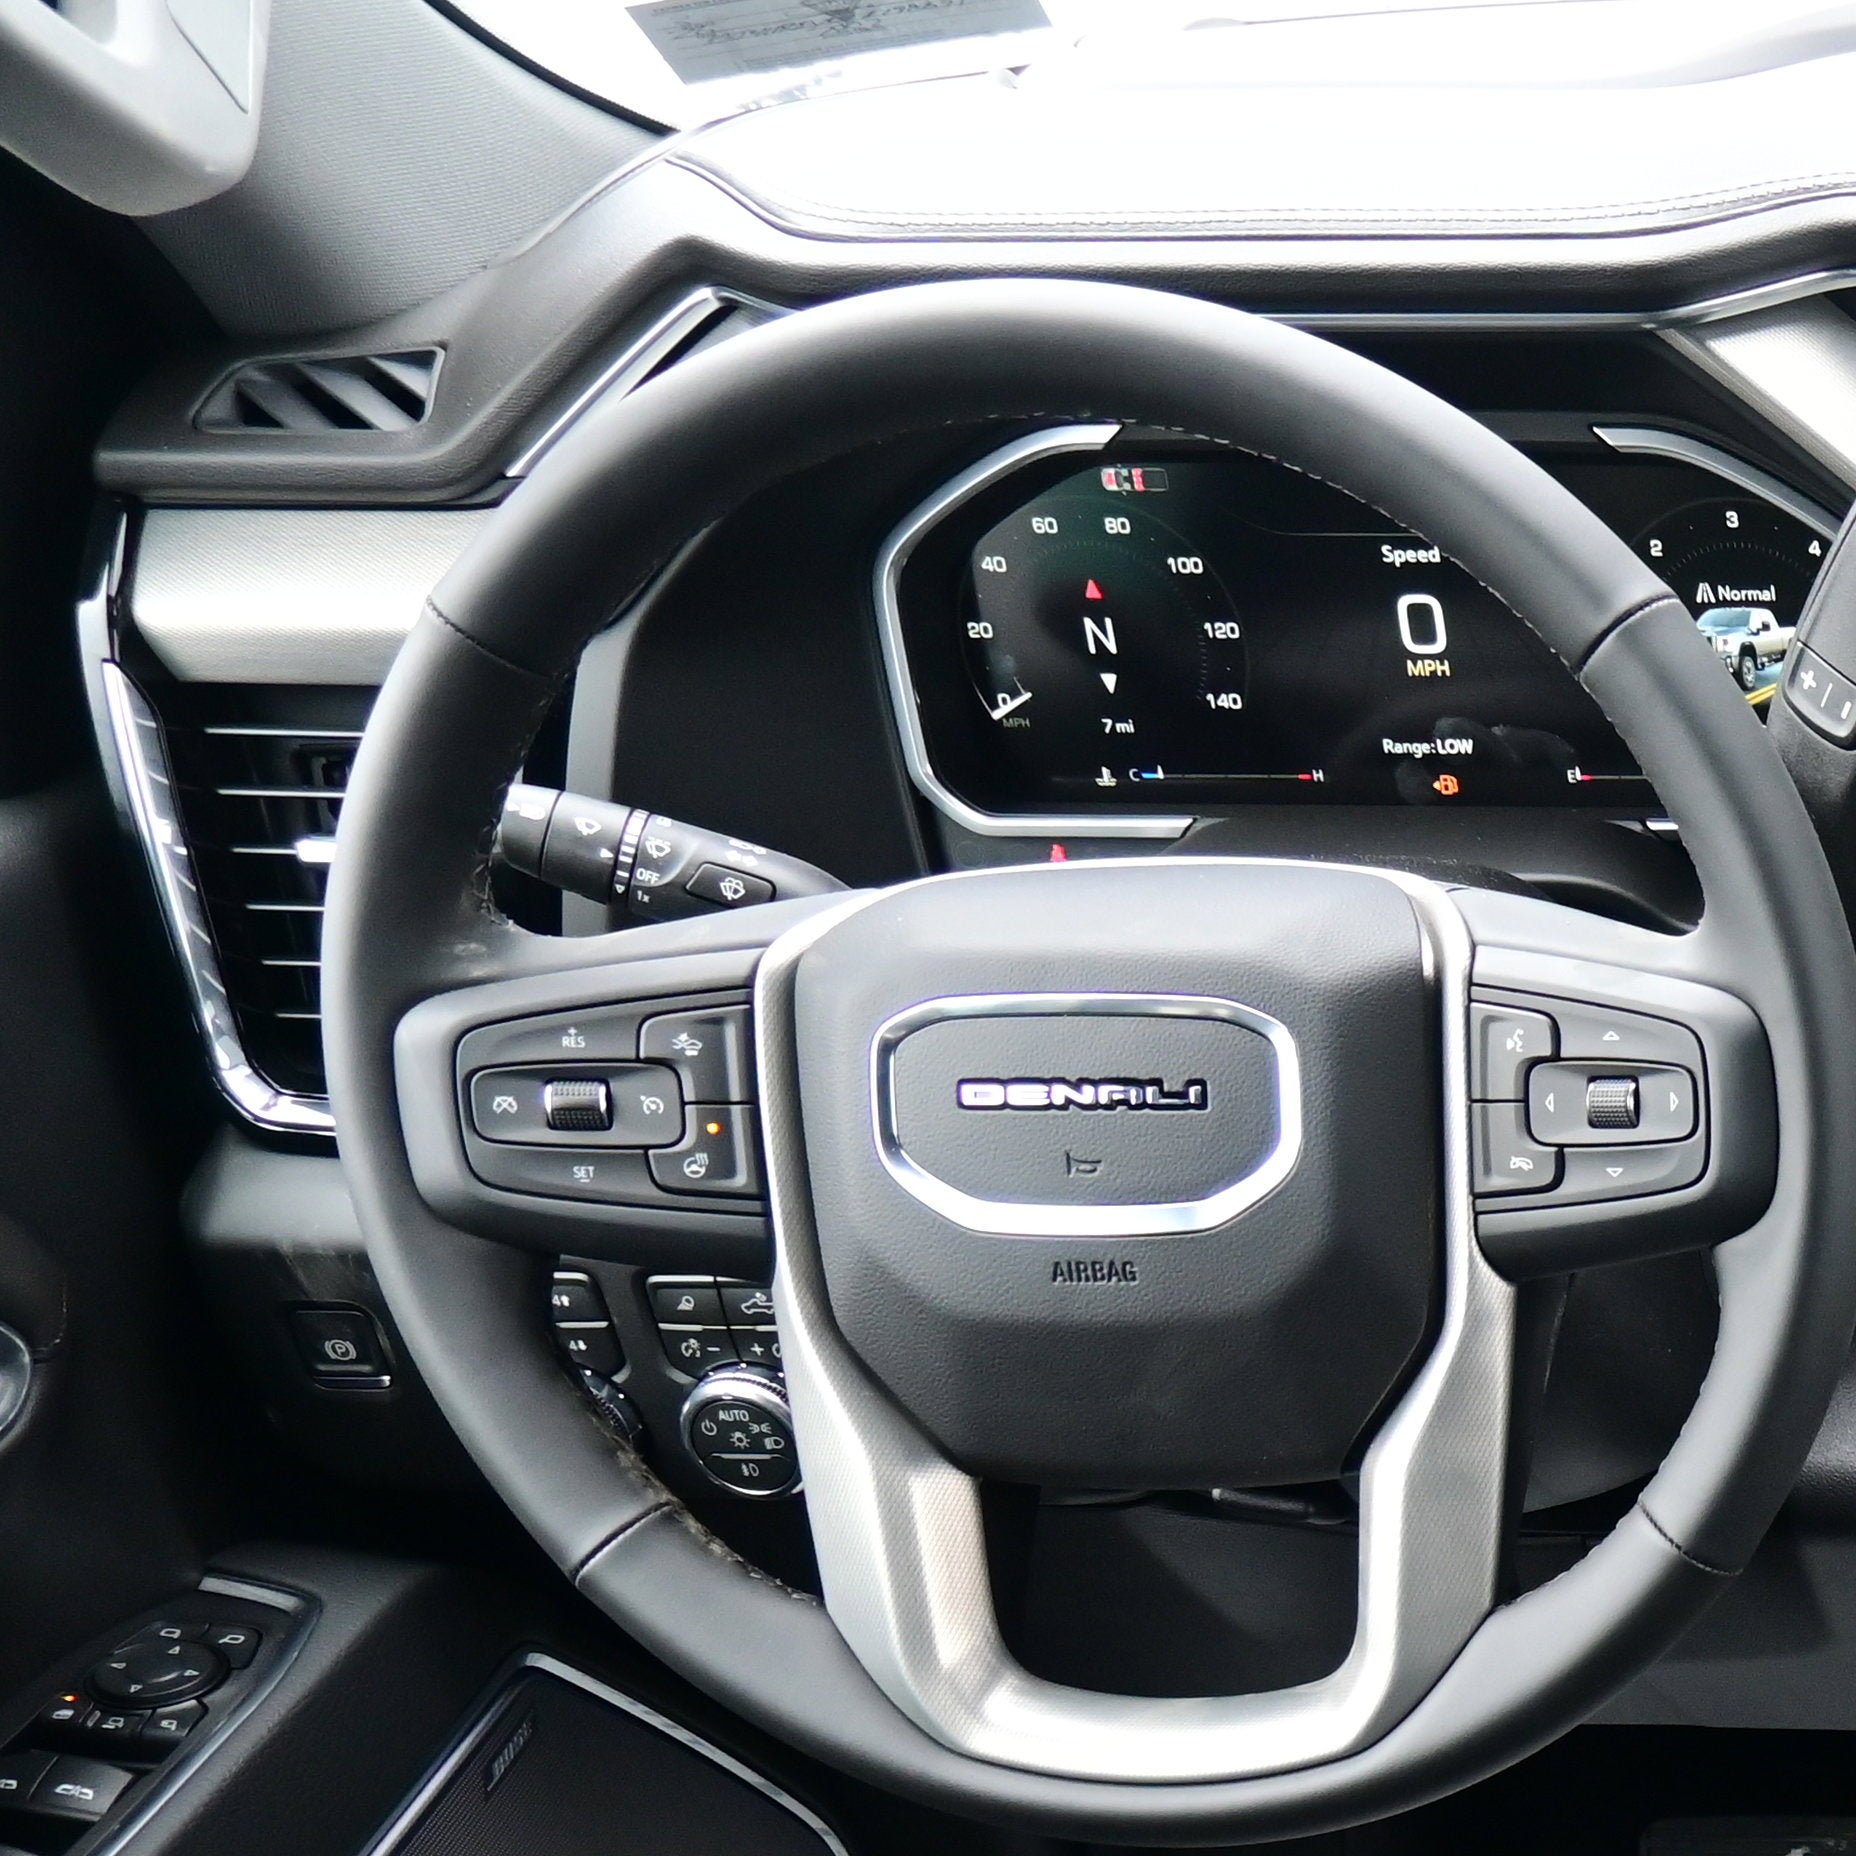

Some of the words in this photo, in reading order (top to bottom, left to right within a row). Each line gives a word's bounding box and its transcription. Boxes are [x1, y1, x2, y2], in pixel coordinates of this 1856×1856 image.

[1032, 517, 1058, 534] 60
[1104, 517, 1131, 535] 80
[1725, 511, 1739, 529] 3
[1381, 545, 1441, 567] Speed
[1649, 539, 1663, 557] 2
[1808, 540, 1821, 558] 4
[981, 556, 1007, 572] 40
[1167, 557, 1204, 574] 100
[1717, 585, 1777, 602] Normal
[967, 622, 993, 639] 20
[1203, 622, 1240, 639] 120
[1397, 594, 1447, 655] 0
[1083, 617, 1118, 655] N
[1406, 659, 1451, 678] MPH
[1205, 693, 1243, 710] 140
[1002, 718, 1031, 729] MPH
[1101, 718, 1113, 734] 7
[1115, 719, 1135, 734] mi
[1312, 770, 1325, 783] H
[636, 868, 660, 885] OFF
[562, 1035, 586, 1048] RES
[959, 1081, 1205, 1109] DENALI
[573, 1166, 594, 1179] SET
[1052, 1259, 1139, 1284] AIRBAG
[718, 1409, 749, 1423] AUTO
